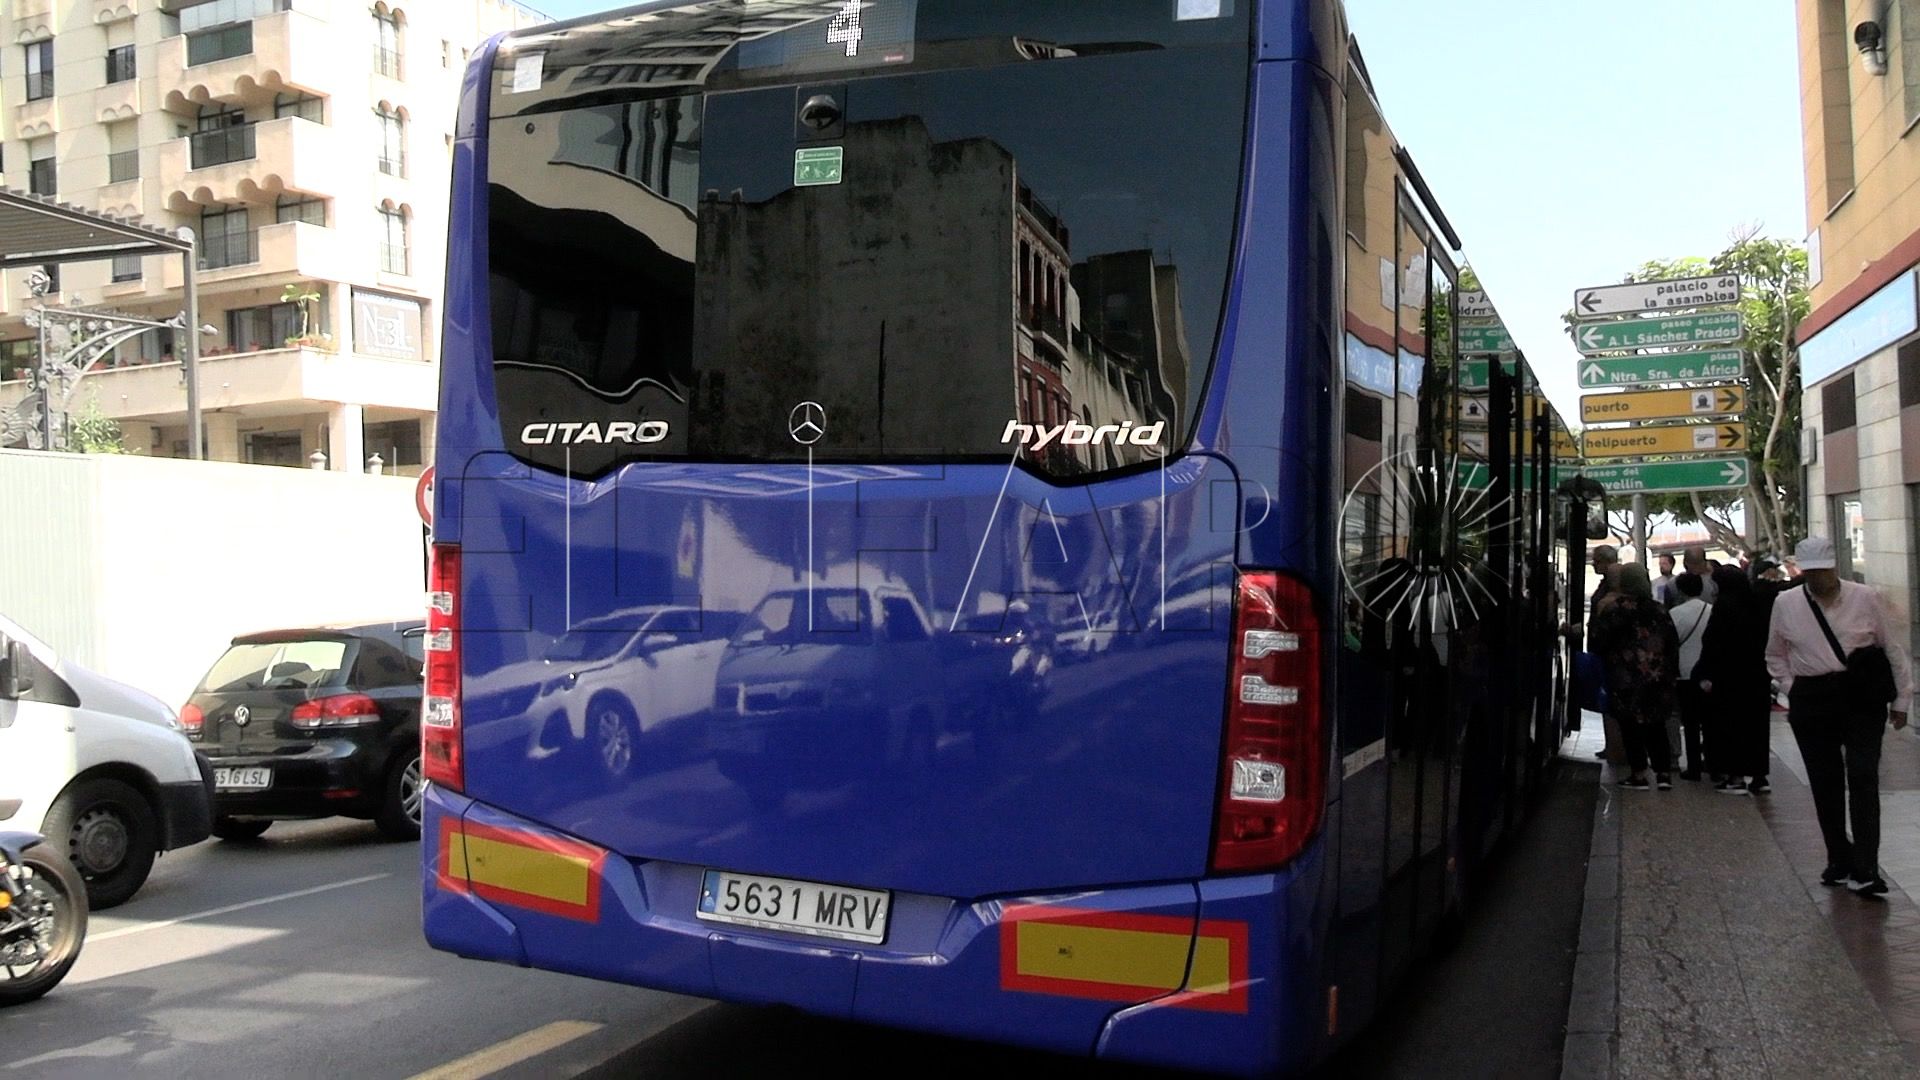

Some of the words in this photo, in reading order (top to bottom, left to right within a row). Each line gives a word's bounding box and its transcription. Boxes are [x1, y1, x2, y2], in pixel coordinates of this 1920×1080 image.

[826, 0, 862, 56] 4
[1657, 279, 1708, 296] palacio
[1718, 277, 1736, 288] de
[1644, 298, 1658, 308] la
[1666, 291, 1736, 306] asamblea
[1660, 319, 1692, 330] paseo
[1698, 314, 1737, 326] alcalde
[1637, 331, 1689, 345] Sánchez
[1695, 326, 1738, 340] Prados
[1710, 351, 1739, 363] plaza
[1610, 371, 1641, 384] Ntra.
[1648, 369, 1672, 380] Sra.
[1679, 367, 1695, 378] de
[1701, 361, 1739, 377] África
[1584, 400, 1630, 415] puerto
[521, 420, 669, 445] CITARO
[1001, 419, 1165, 451] hybrid
[1585, 435, 1658, 449] helipuerto
[1623, 467, 1640, 476] del
[1600, 478, 1644, 490] vellín
[242, 770, 265, 785] LSL
[724, 879, 802, 921] 5631
[815, 890, 881, 931] MRV
